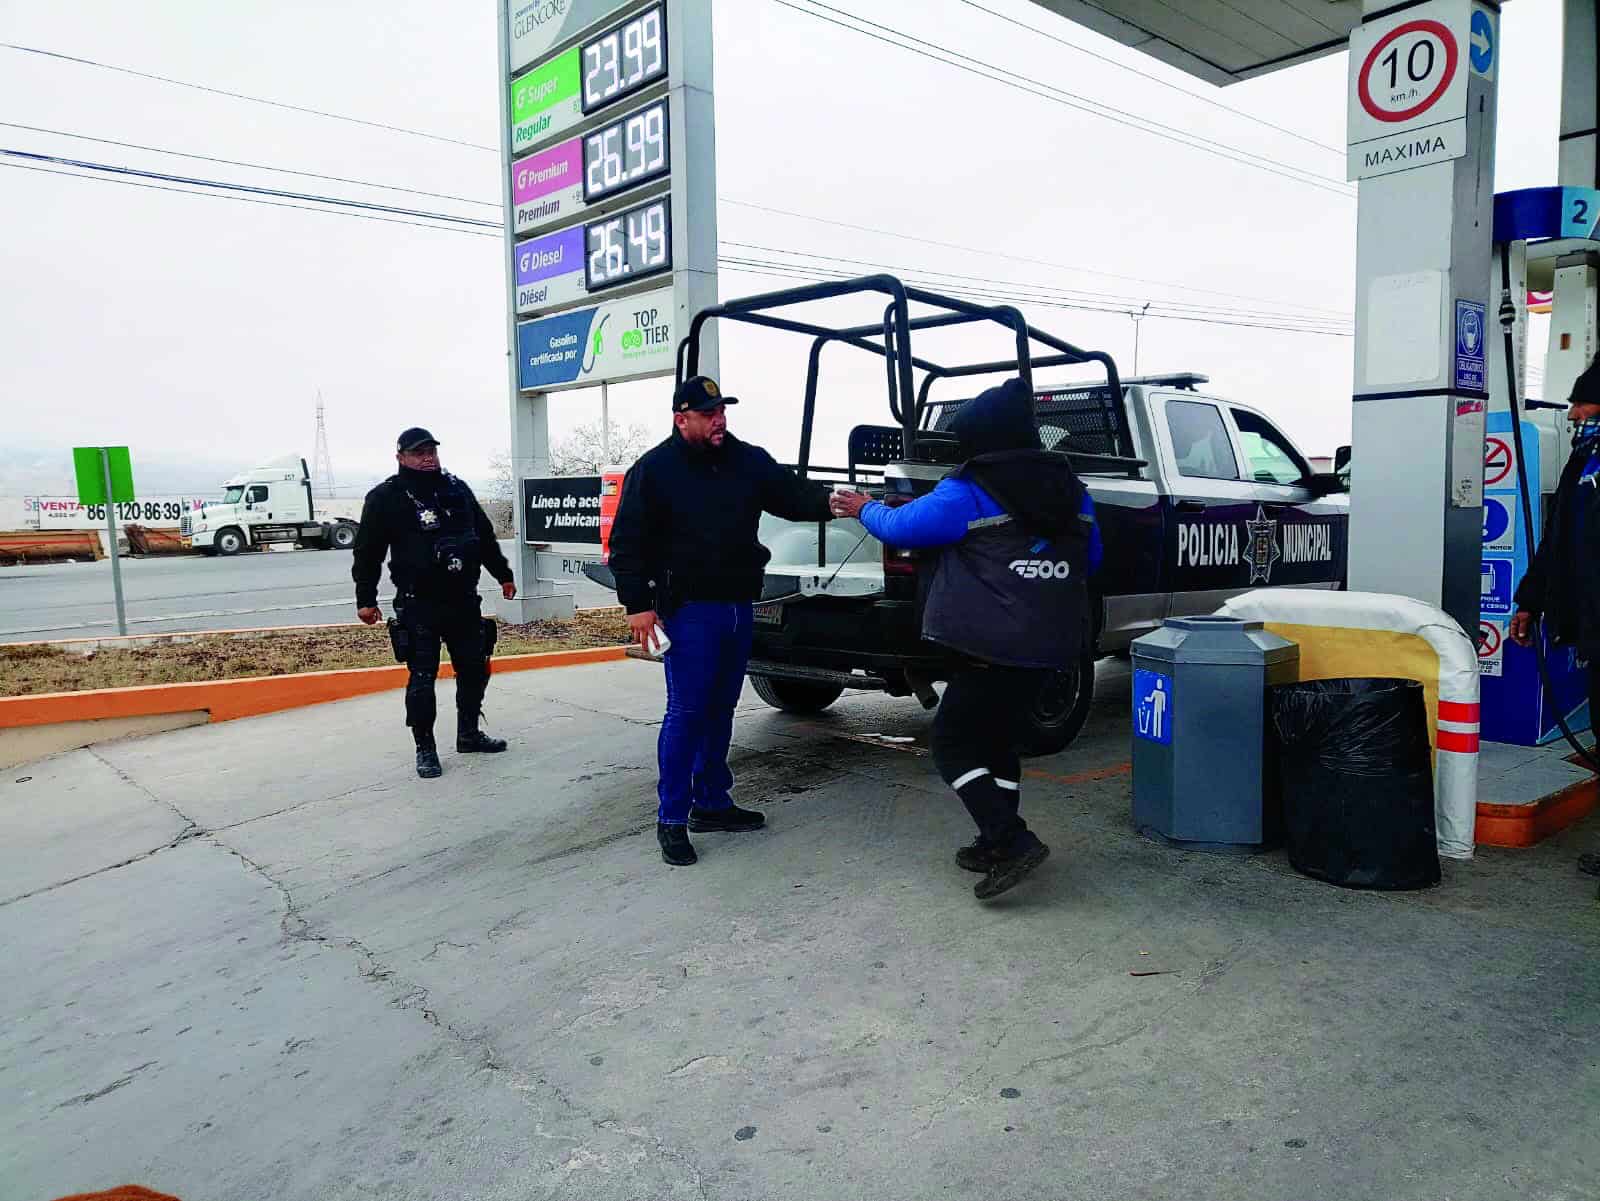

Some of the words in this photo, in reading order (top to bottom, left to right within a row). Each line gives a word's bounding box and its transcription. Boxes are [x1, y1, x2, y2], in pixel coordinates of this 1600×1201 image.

[584, 10, 662, 104] 23.99
[1382, 40, 1434, 88] 10
[528, 79, 558, 104] Super
[516, 115, 551, 143] Regular
[587, 106, 664, 193] 26.99
[1364, 136, 1446, 168] MAXIMA
[529, 160, 568, 186] Premium
[519, 200, 560, 225] Premium
[1572, 199, 1588, 224] 2
[589, 205, 666, 283] 26.49
[532, 245, 563, 270] Diesel
[632, 308, 658, 328] TOP
[550, 333, 577, 348] Gasolina
[643, 325, 669, 345] TIER
[530, 351, 563, 366] certificada
[564, 350, 577, 362] por
[40, 502, 85, 511] VENTA
[531, 494, 560, 509] Línea
[562, 494, 577, 508] de
[545, 516, 553, 529] y
[1177, 523, 1239, 568] POLICIA
[1282, 523, 1332, 564] MUNICIPAL
